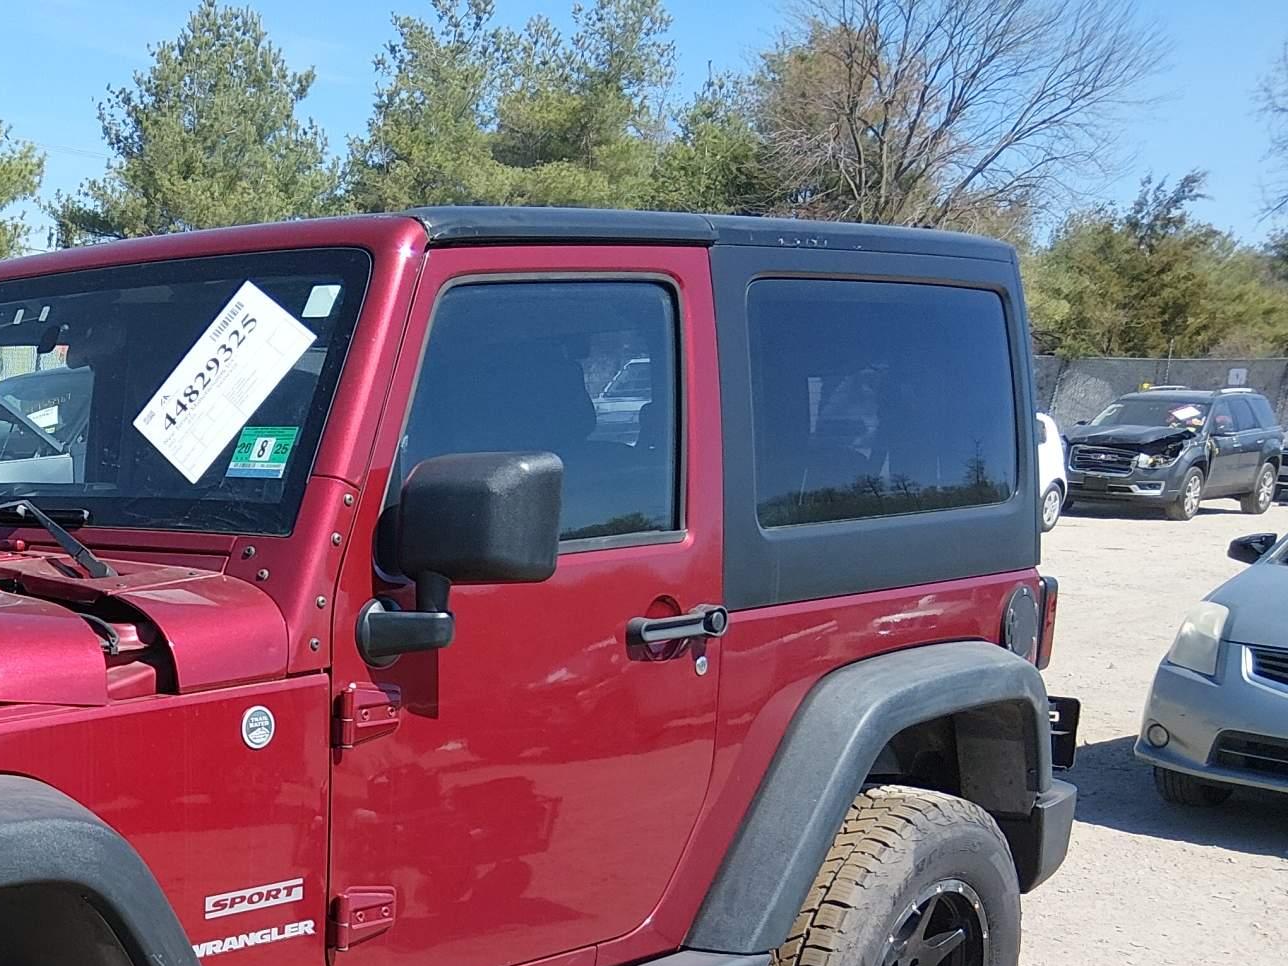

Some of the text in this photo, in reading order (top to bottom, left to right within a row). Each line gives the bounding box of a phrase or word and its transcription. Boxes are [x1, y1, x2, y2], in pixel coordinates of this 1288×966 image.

[163, 312, 257, 432] 44829325
[238, 440, 289, 458] 20 8 25
[211, 885, 296, 912] SPORT
